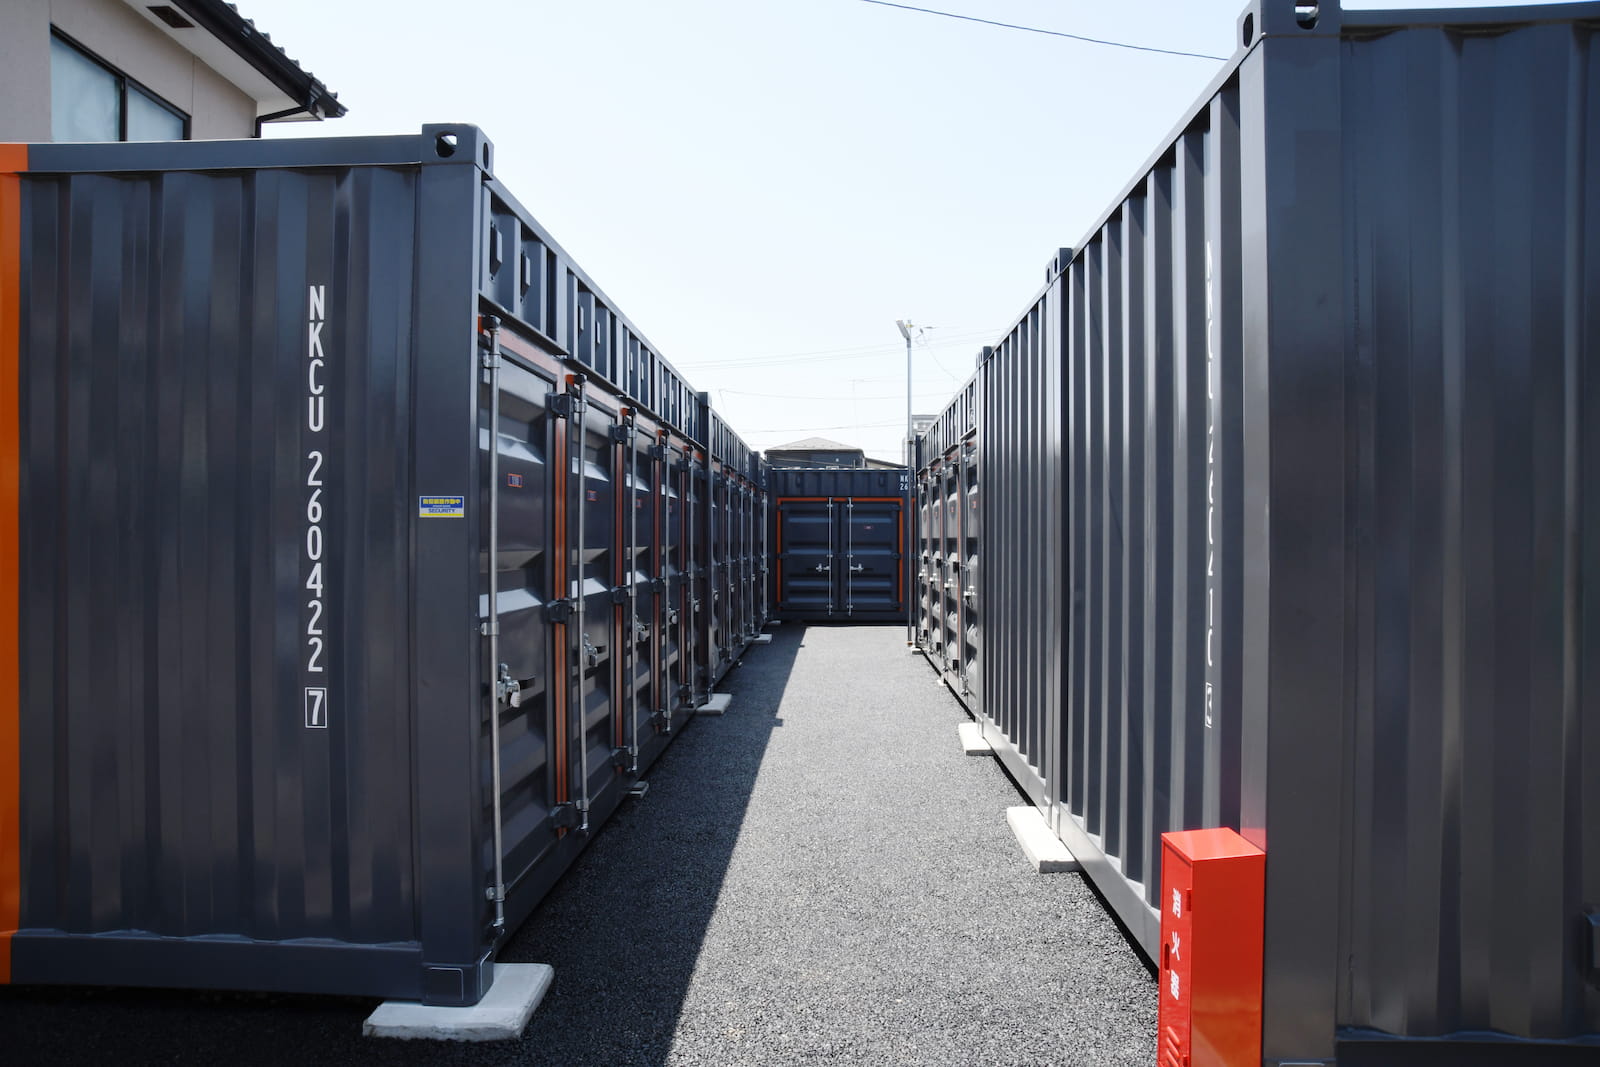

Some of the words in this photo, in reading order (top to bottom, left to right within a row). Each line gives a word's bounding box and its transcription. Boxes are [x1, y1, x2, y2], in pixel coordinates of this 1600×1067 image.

[308, 285, 325, 432] NKCU
[306, 450, 323, 672] 260422
[307, 689, 324, 726] 7
